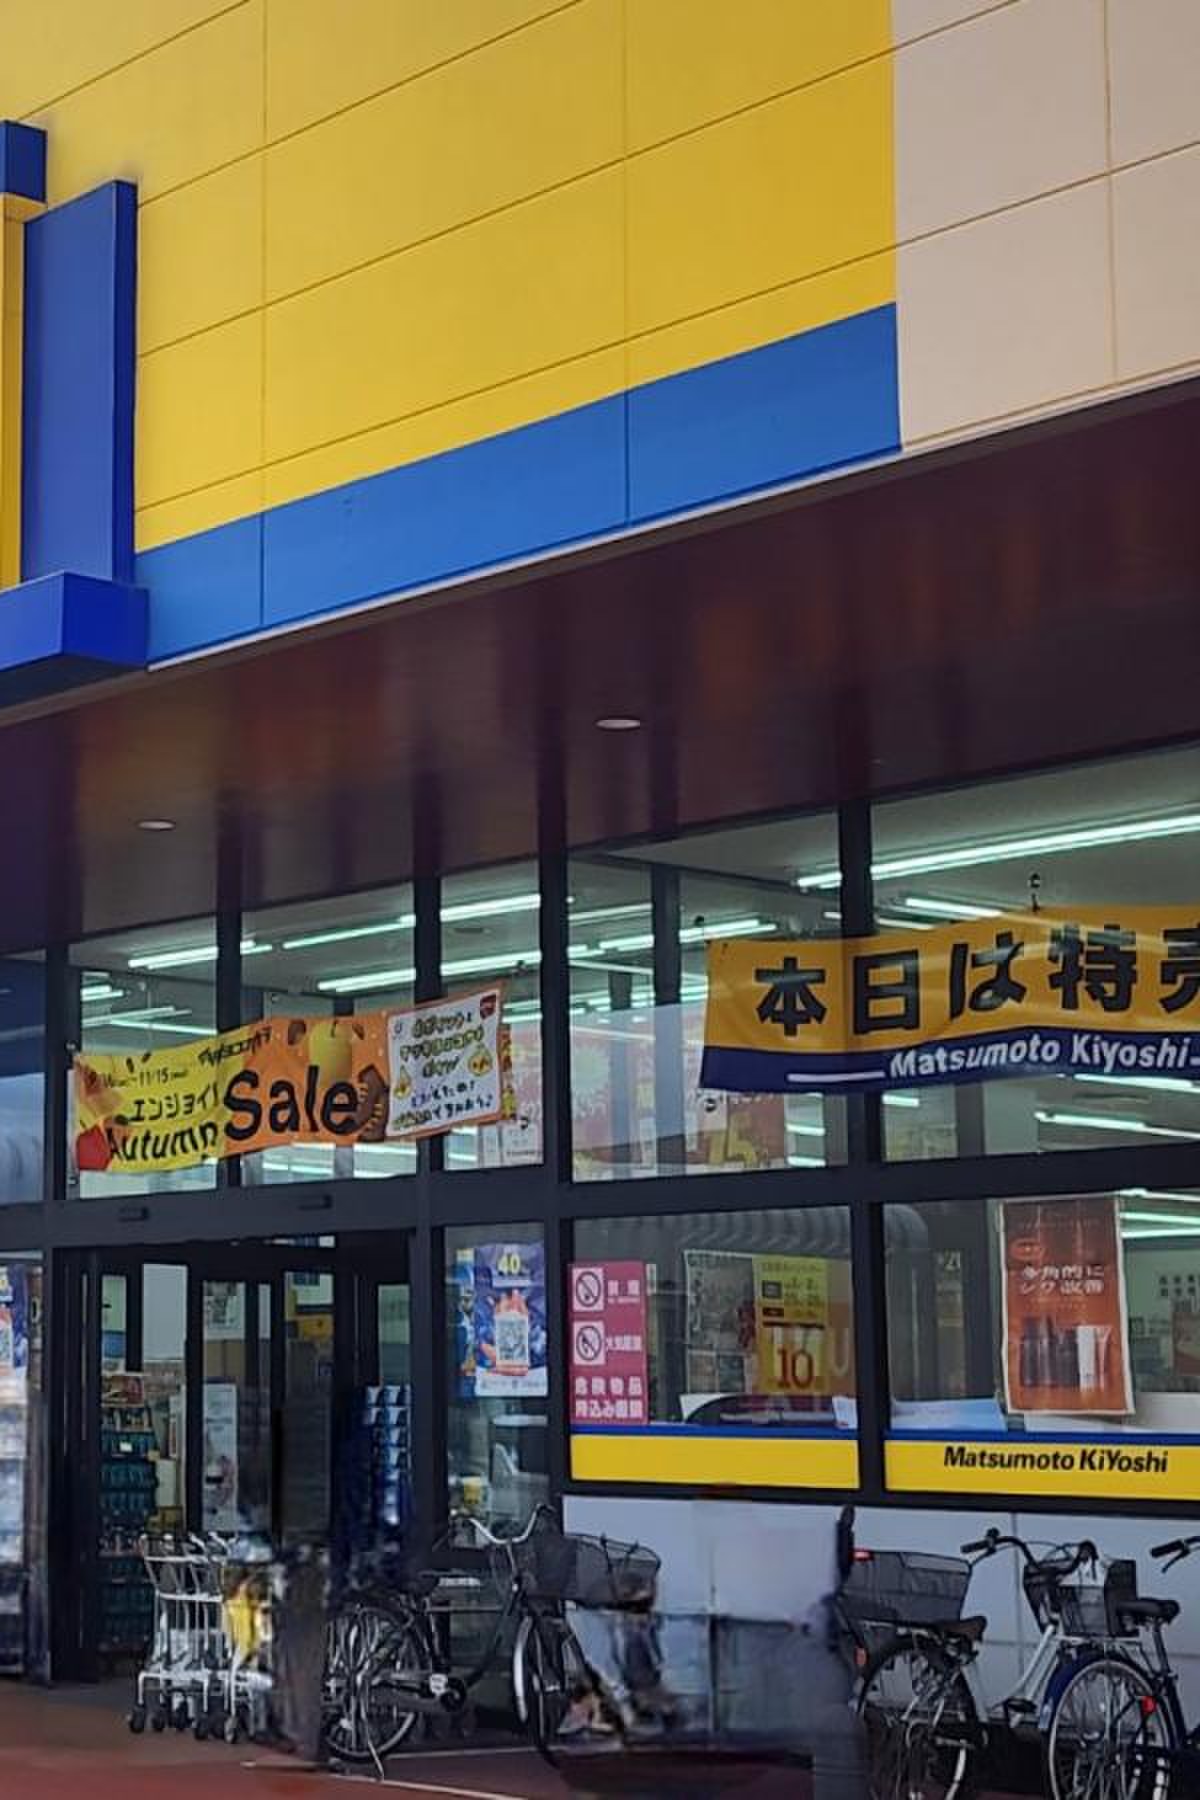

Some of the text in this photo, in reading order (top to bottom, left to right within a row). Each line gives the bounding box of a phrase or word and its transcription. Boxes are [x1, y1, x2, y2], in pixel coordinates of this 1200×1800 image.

[890, 1034, 1060, 1078] Matsumoto
[223, 1064, 361, 1141] Sale
[105, 1120, 219, 1162] Autumn
[943, 1446, 1169, 1473] Matsumoto KiYoshi
